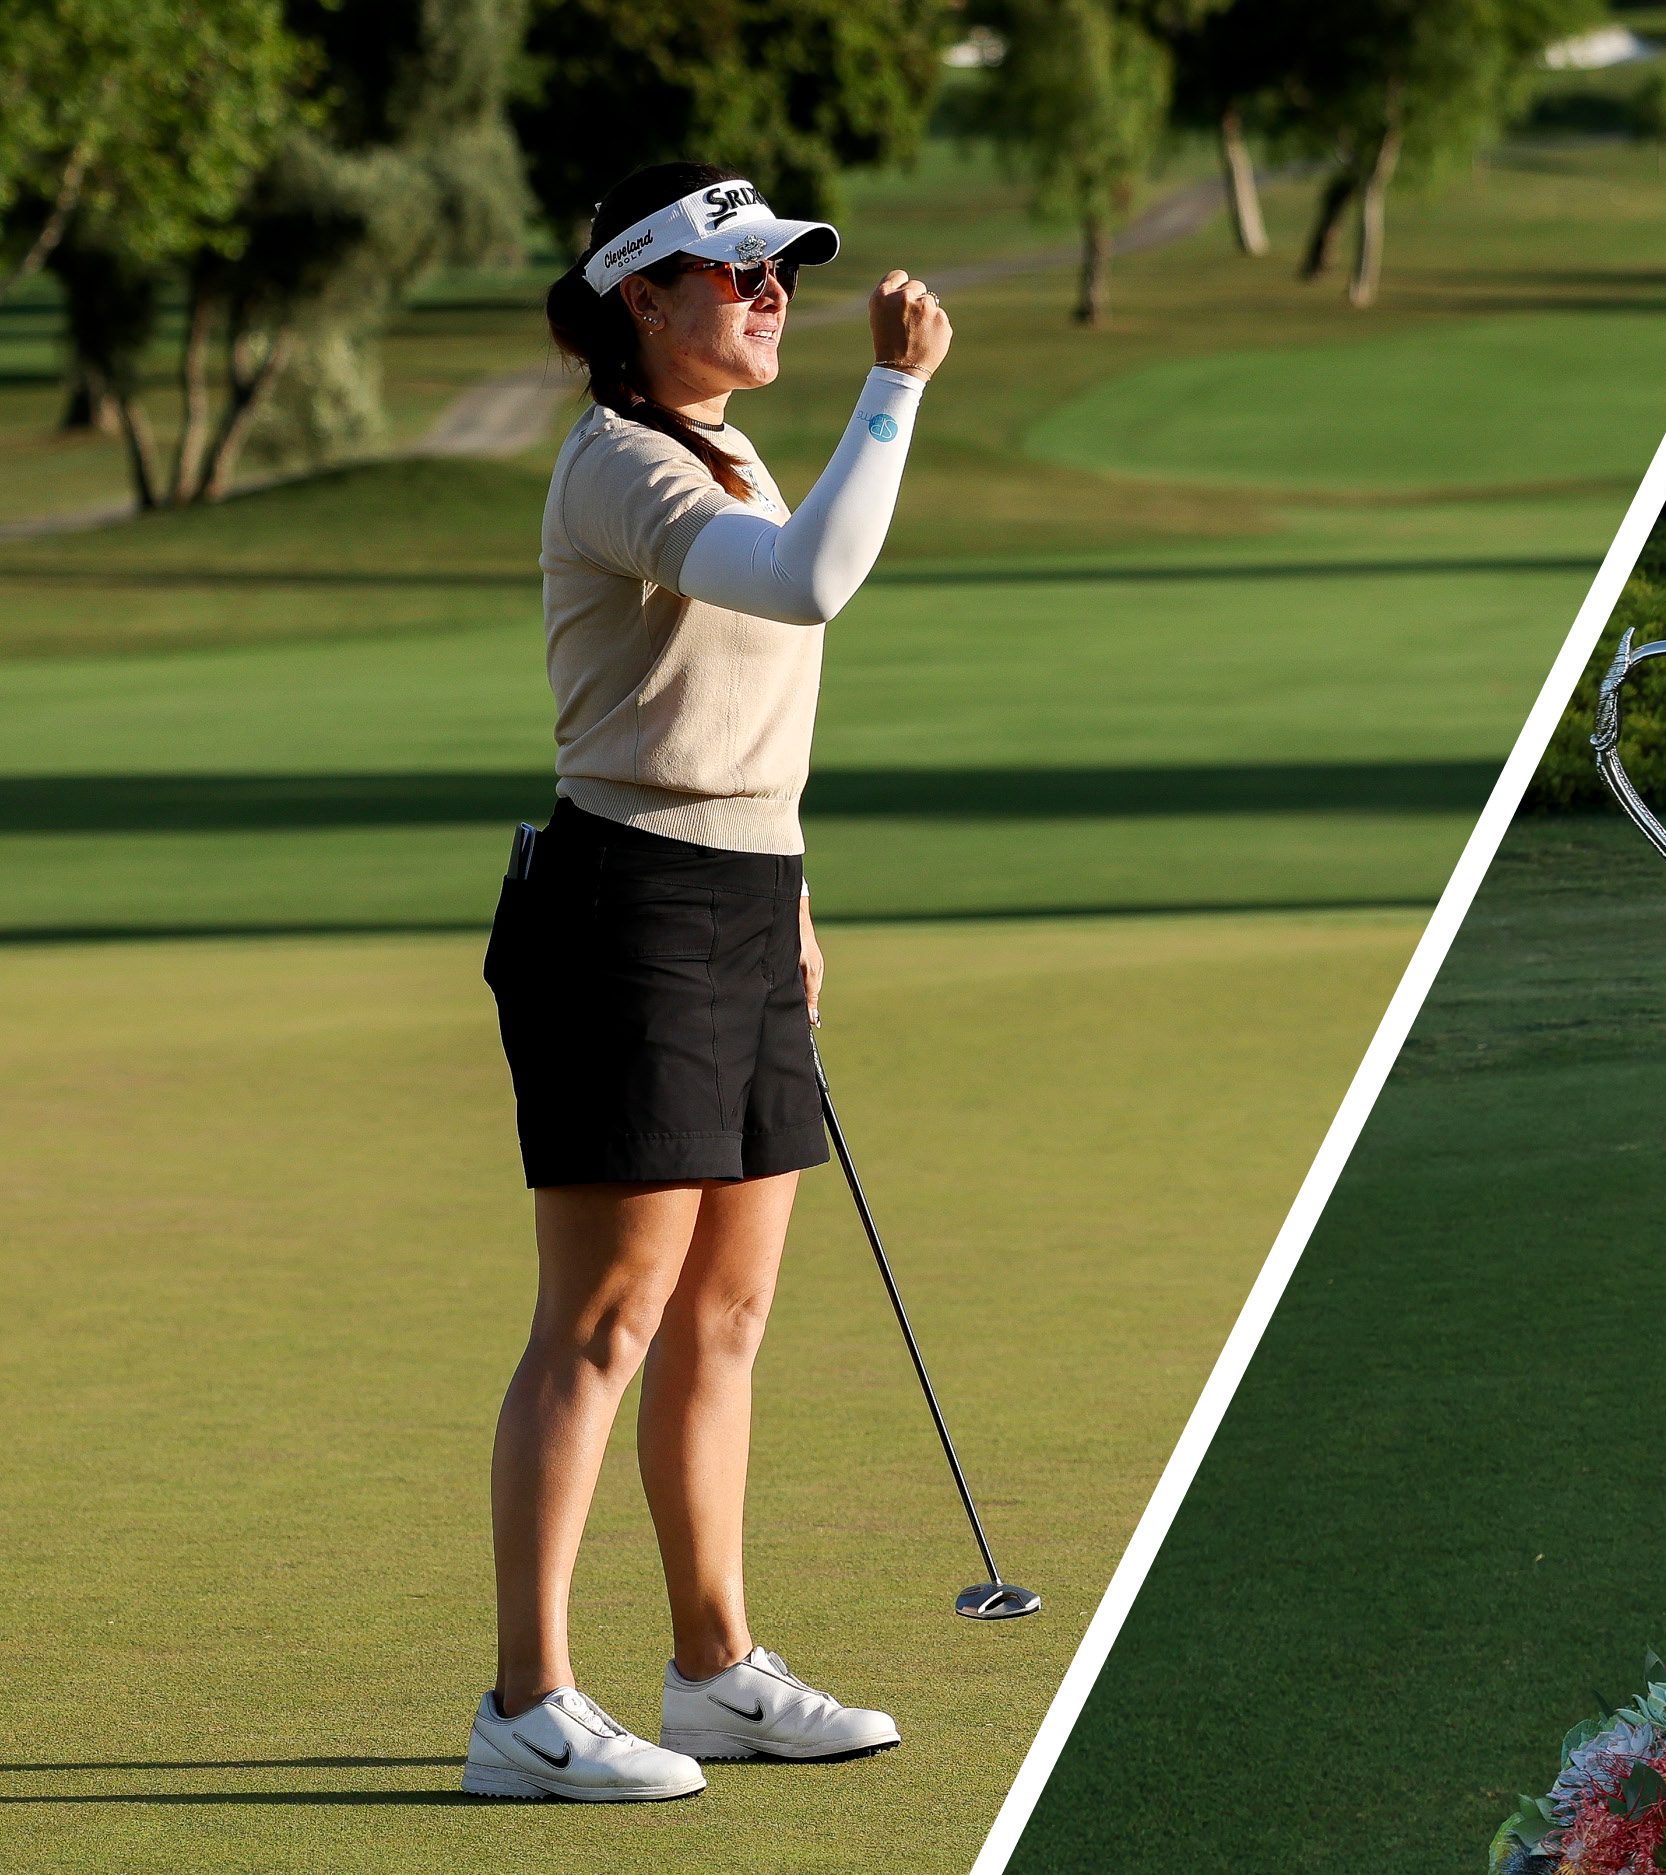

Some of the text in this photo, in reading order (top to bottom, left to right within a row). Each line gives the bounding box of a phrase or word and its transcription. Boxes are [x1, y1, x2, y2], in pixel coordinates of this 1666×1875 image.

[703, 187, 768, 230] SRIX
[605, 229, 653, 268] Cleveland
[618, 250, 643, 267] GOLF
